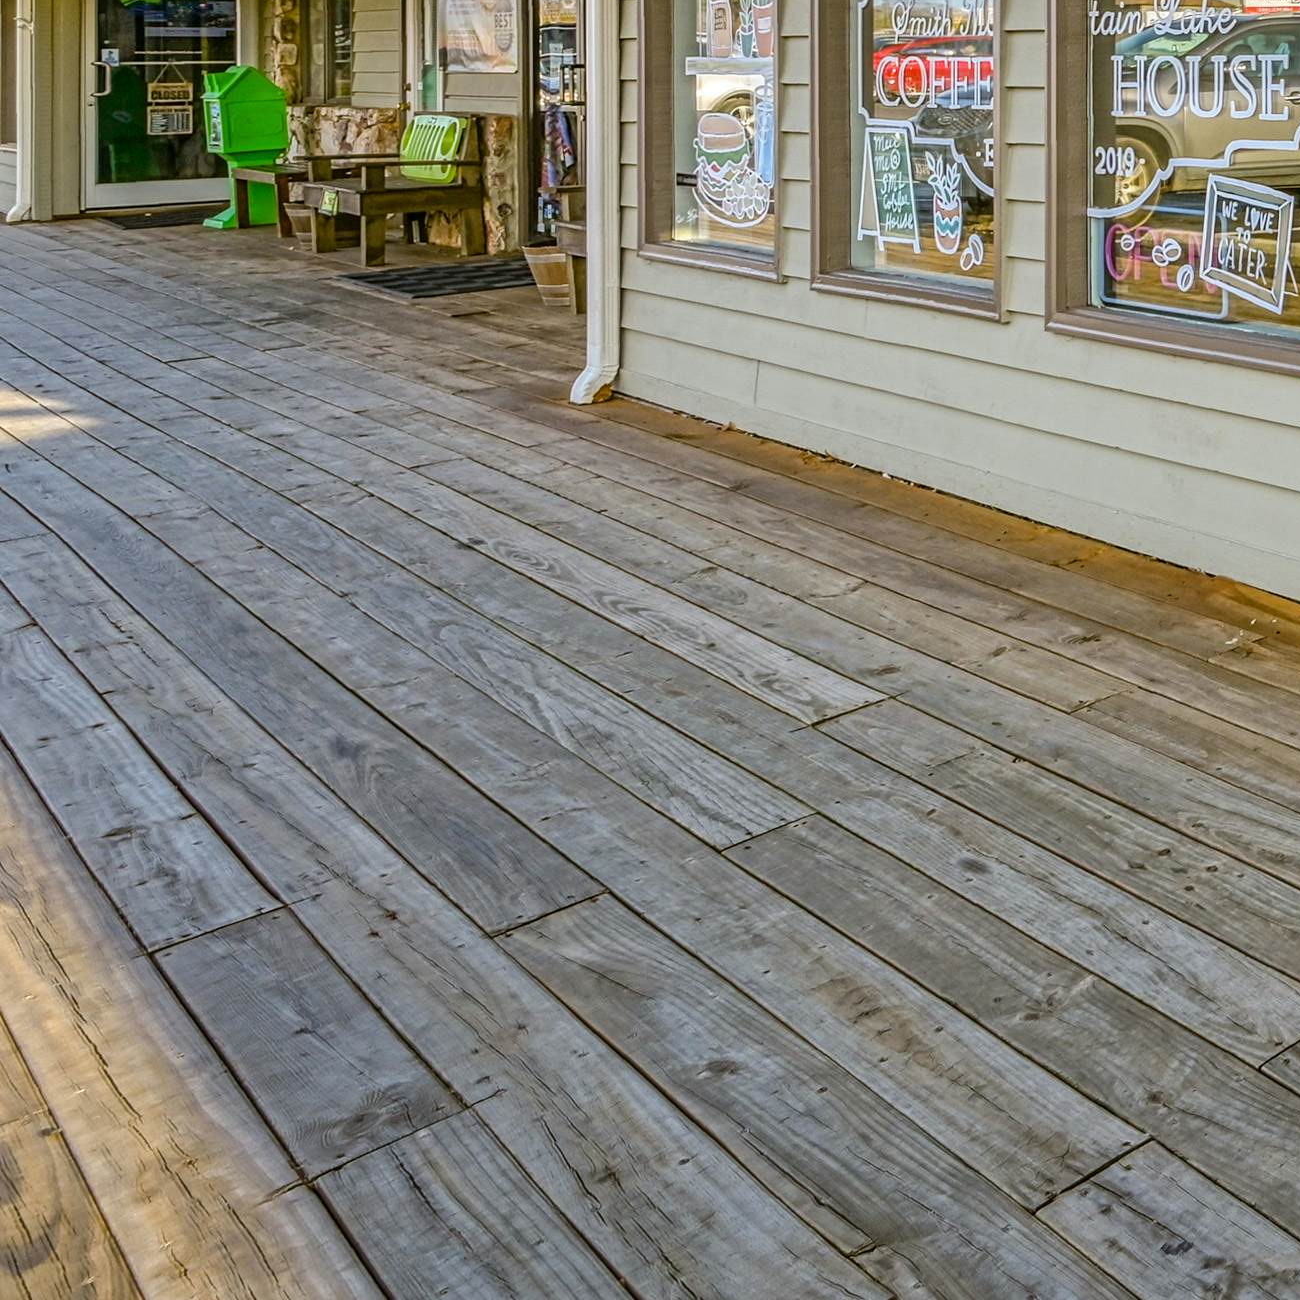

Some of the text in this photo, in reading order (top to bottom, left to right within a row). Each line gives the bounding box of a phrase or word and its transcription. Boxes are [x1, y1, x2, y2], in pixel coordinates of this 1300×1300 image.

[495, 14, 513, 29] BEST
[151, 90, 190, 100] CLOSED
[1110, 55, 1290, 121] HOUSE
[1094, 146, 1136, 175] 2019
[1222, 199, 1239, 221] WE
[885, 212, 914, 232] House
[1236, 226, 1251, 245] TO
[1218, 237, 1268, 285] CATER
